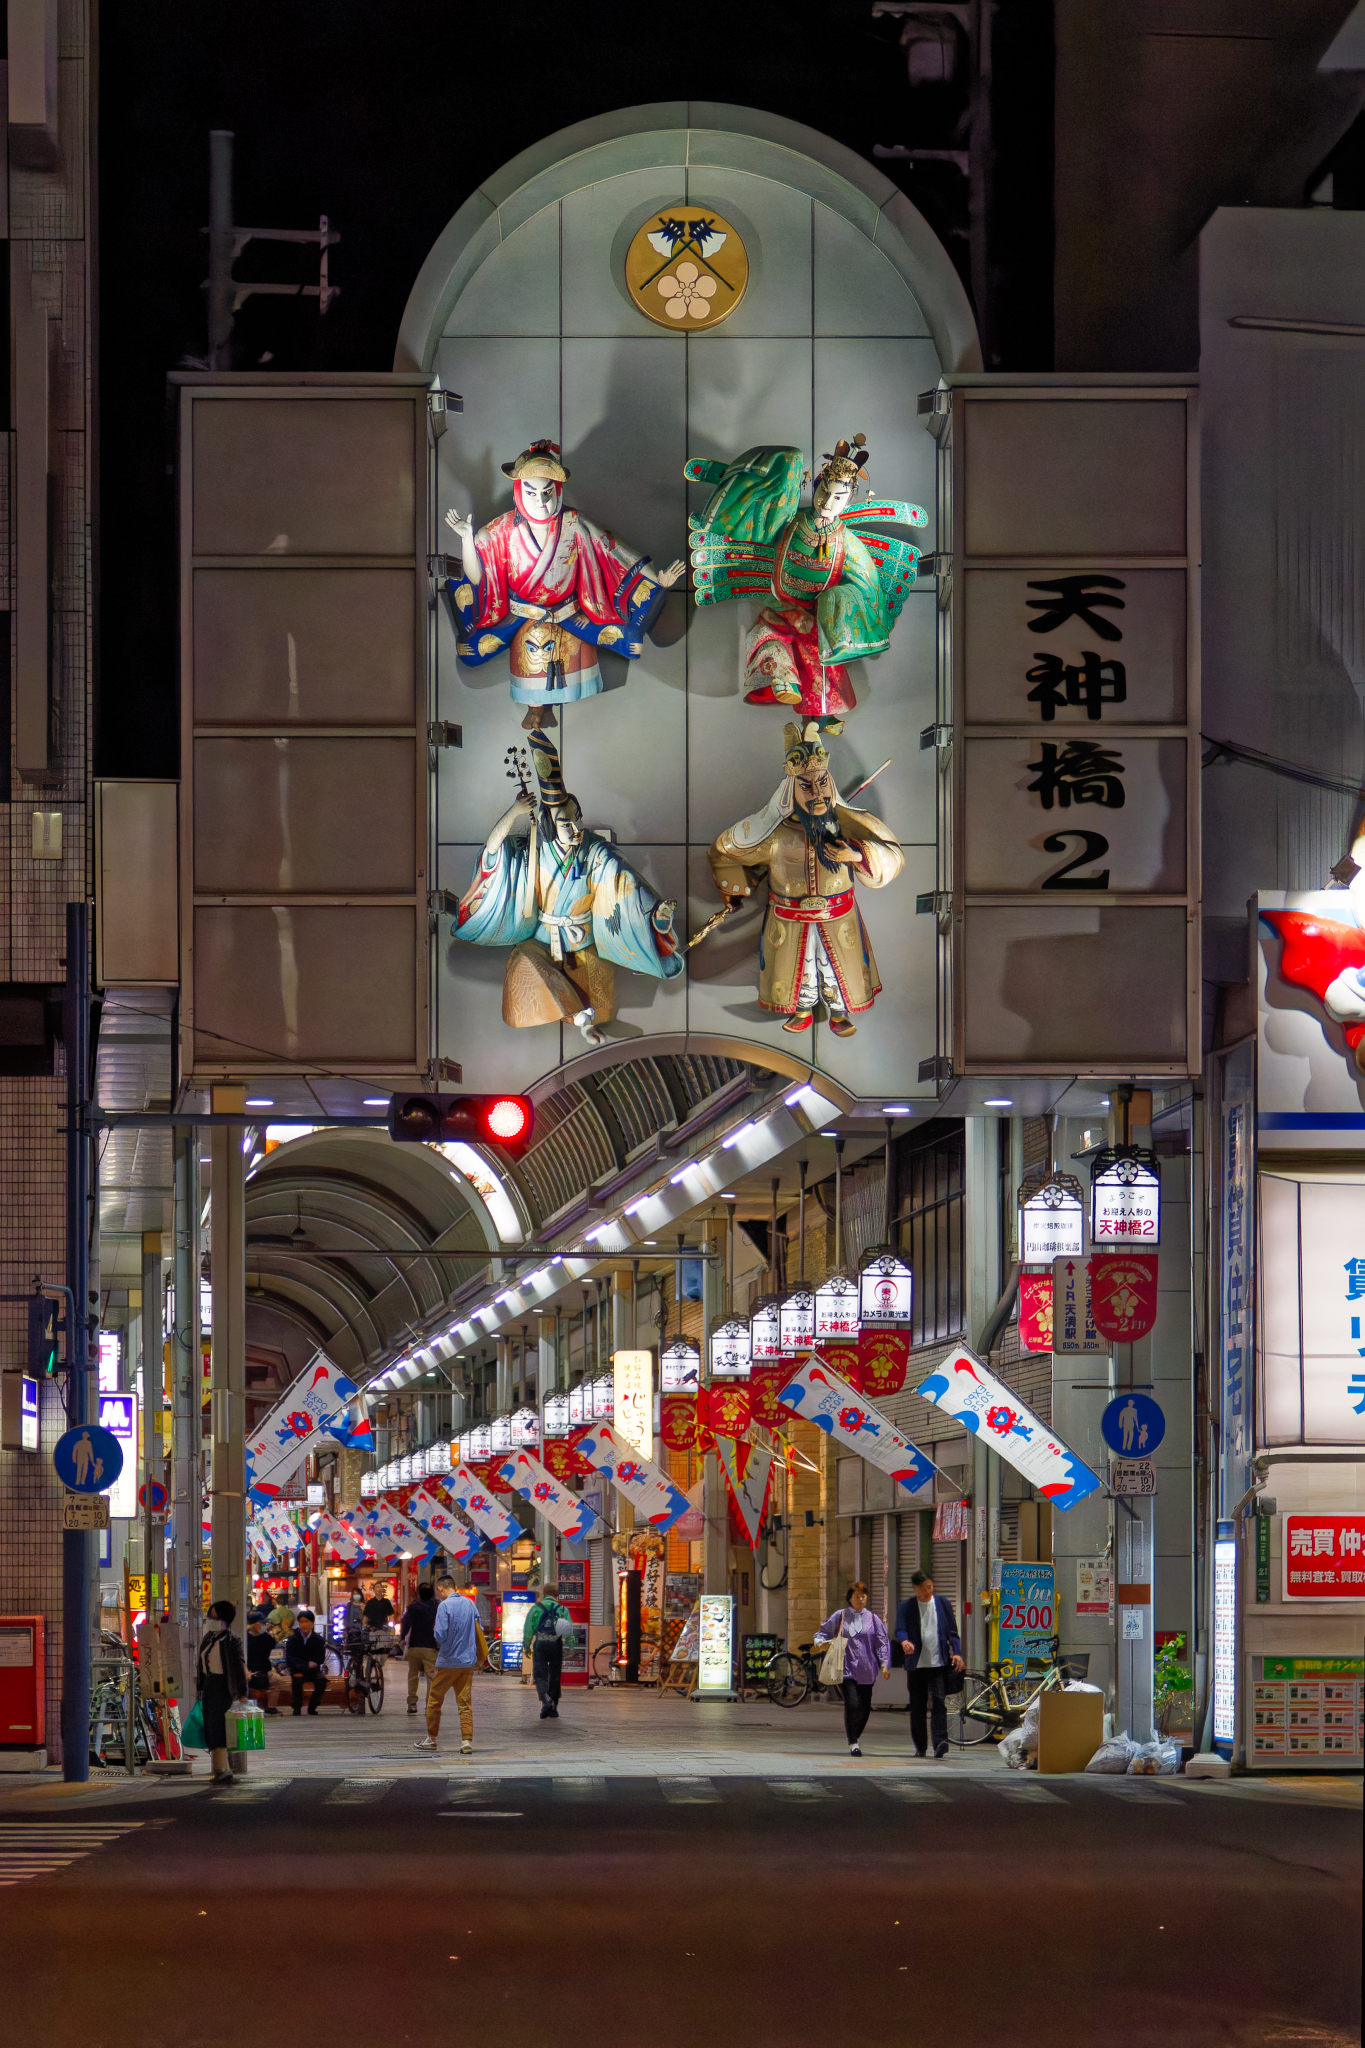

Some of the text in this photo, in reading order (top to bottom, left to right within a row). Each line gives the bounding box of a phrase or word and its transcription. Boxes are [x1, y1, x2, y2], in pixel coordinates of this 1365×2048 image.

[1100, 1220, 1155, 1236] 天神橋2
[818, 1320, 860, 1333] 天神橋2
[301, 1397, 323, 1417] 2025
[304, 1390, 329, 1411] EXPO
[1290, 1528, 1365, 1557] 売買 仲
[1001, 1605, 1053, 1629] 2500
